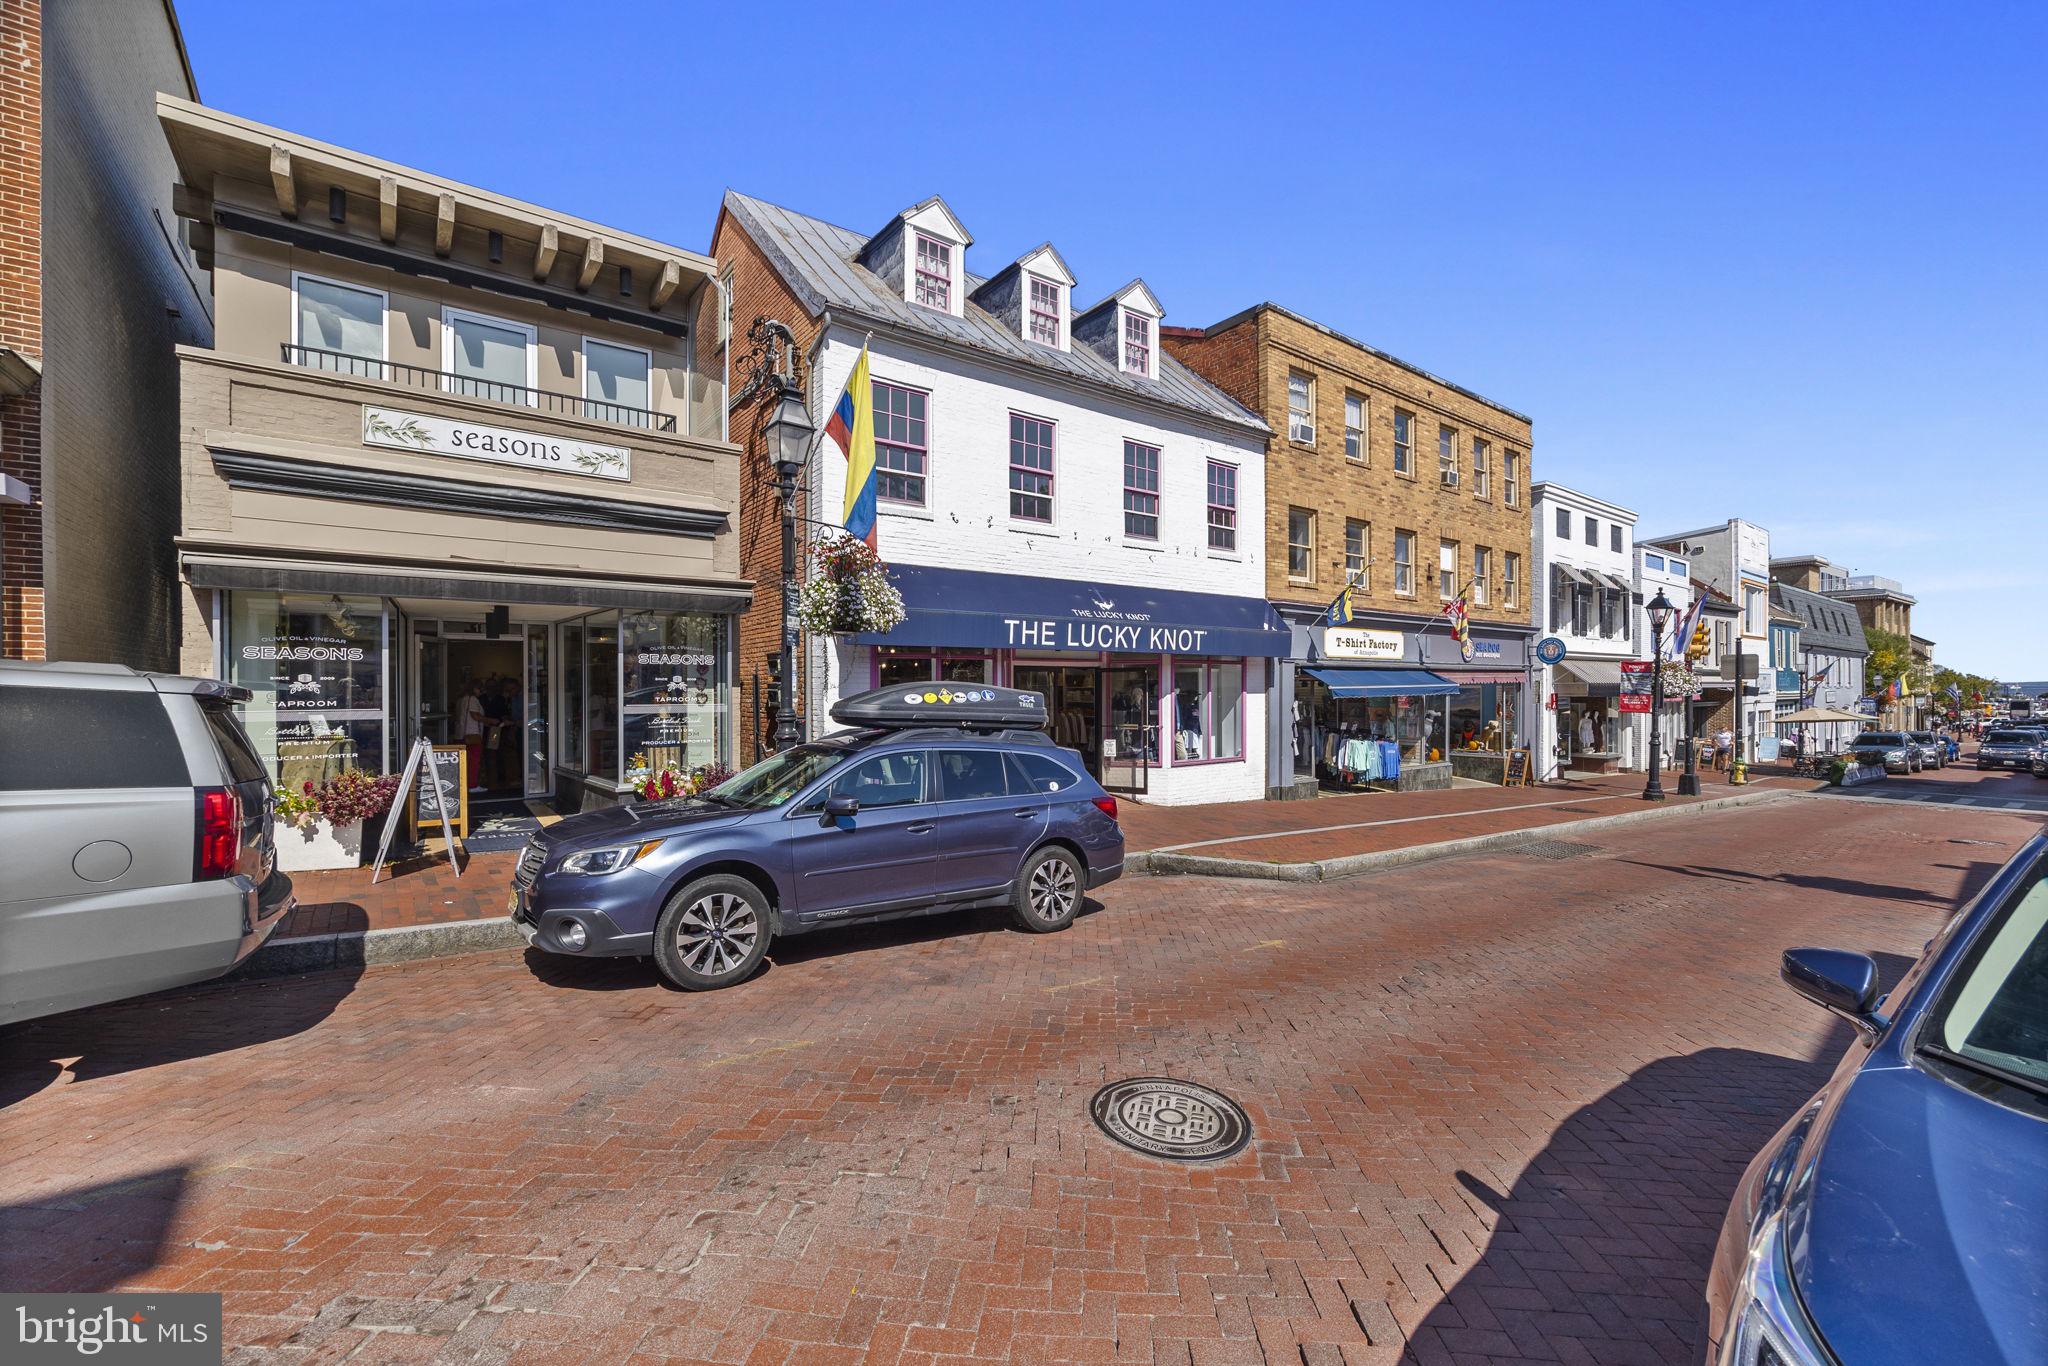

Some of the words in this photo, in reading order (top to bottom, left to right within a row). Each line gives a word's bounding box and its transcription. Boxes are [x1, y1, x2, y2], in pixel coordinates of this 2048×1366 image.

[452, 429, 561, 462] seasons
[1071, 608, 1093, 618] THE
[1095, 609, 1124, 620] LUCKY
[1125, 612, 1150, 622] KNOT
[309, 636, 347, 644] VINEGAR
[1004, 619, 1056, 646] THE
[1067, 623, 1142, 649] LUCKY
[1150, 627, 1206, 651] KNOT
[1336, 637, 1367, 649] T-Shirt
[1368, 639, 1398, 652] Factory
[242, 645, 364, 661] SEASONS
[637, 653, 715, 666] SEASONS
[271, 700, 337, 708] TAPROOM
[1138, 1084, 1207, 1100] ANNAPOLIS
[1115, 1124, 1167, 1152] SANITARY
[1183, 1142, 1225, 1155] SEWER
